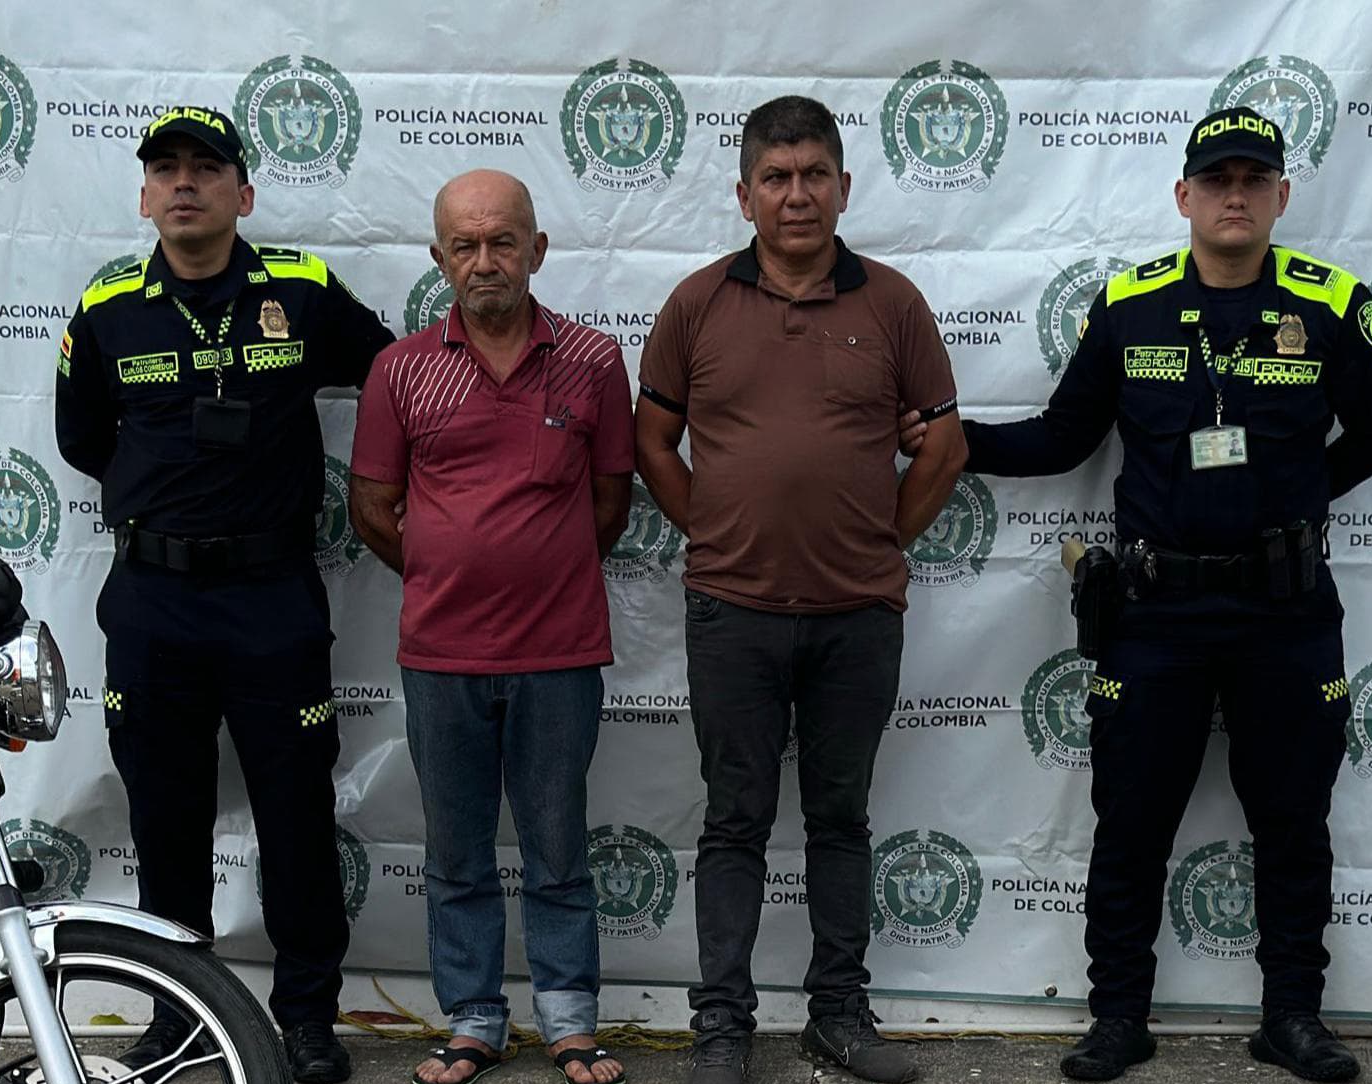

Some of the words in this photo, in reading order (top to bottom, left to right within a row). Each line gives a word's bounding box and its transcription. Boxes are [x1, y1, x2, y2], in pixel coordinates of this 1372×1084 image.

[46, 101, 120, 117] POLICÍA
[375, 107, 447, 123] POLICÍA
[453, 110, 548, 125] NACIONAL
[696, 112, 749, 126] POLIC
[1019, 109, 1090, 126] POLICÍA
[1096, 110, 1193, 124] NACIONAL
[72, 124, 95, 137] DE
[101, 125, 148, 139] COLO
[400, 131, 423, 144] DE
[428, 132, 524, 146] COLOMBIA
[719, 134, 742, 147] DE
[1042, 134, 1064, 147] DE
[1071, 132, 1168, 147] COLOMBIA
[1285, 134, 1317, 162] CIONAL
[943, 332, 1001, 345] OMBIA
[1152, 358, 1183, 368] ROJAS
[1007, 508, 1077, 525] POLICÍA
[1030, 532, 1053, 544] DE
[1350, 534, 1372, 547] DE
[333, 687, 395, 699] CIONAL
[610, 694, 690, 707] NACIONA
[919, 696, 1011, 710] NACIONAL
[600, 711, 679, 725] OLOMBIA
[896, 715, 987, 729] COLOMBIA
[99, 847, 137, 859] POLI
[405, 884, 427, 896] DE
[992, 877, 1060, 893] POLICÍA
[1014, 898, 1037, 911] DE
[1041, 899, 1086, 914] COLO
[1230, 932, 1260, 947] NACIO
